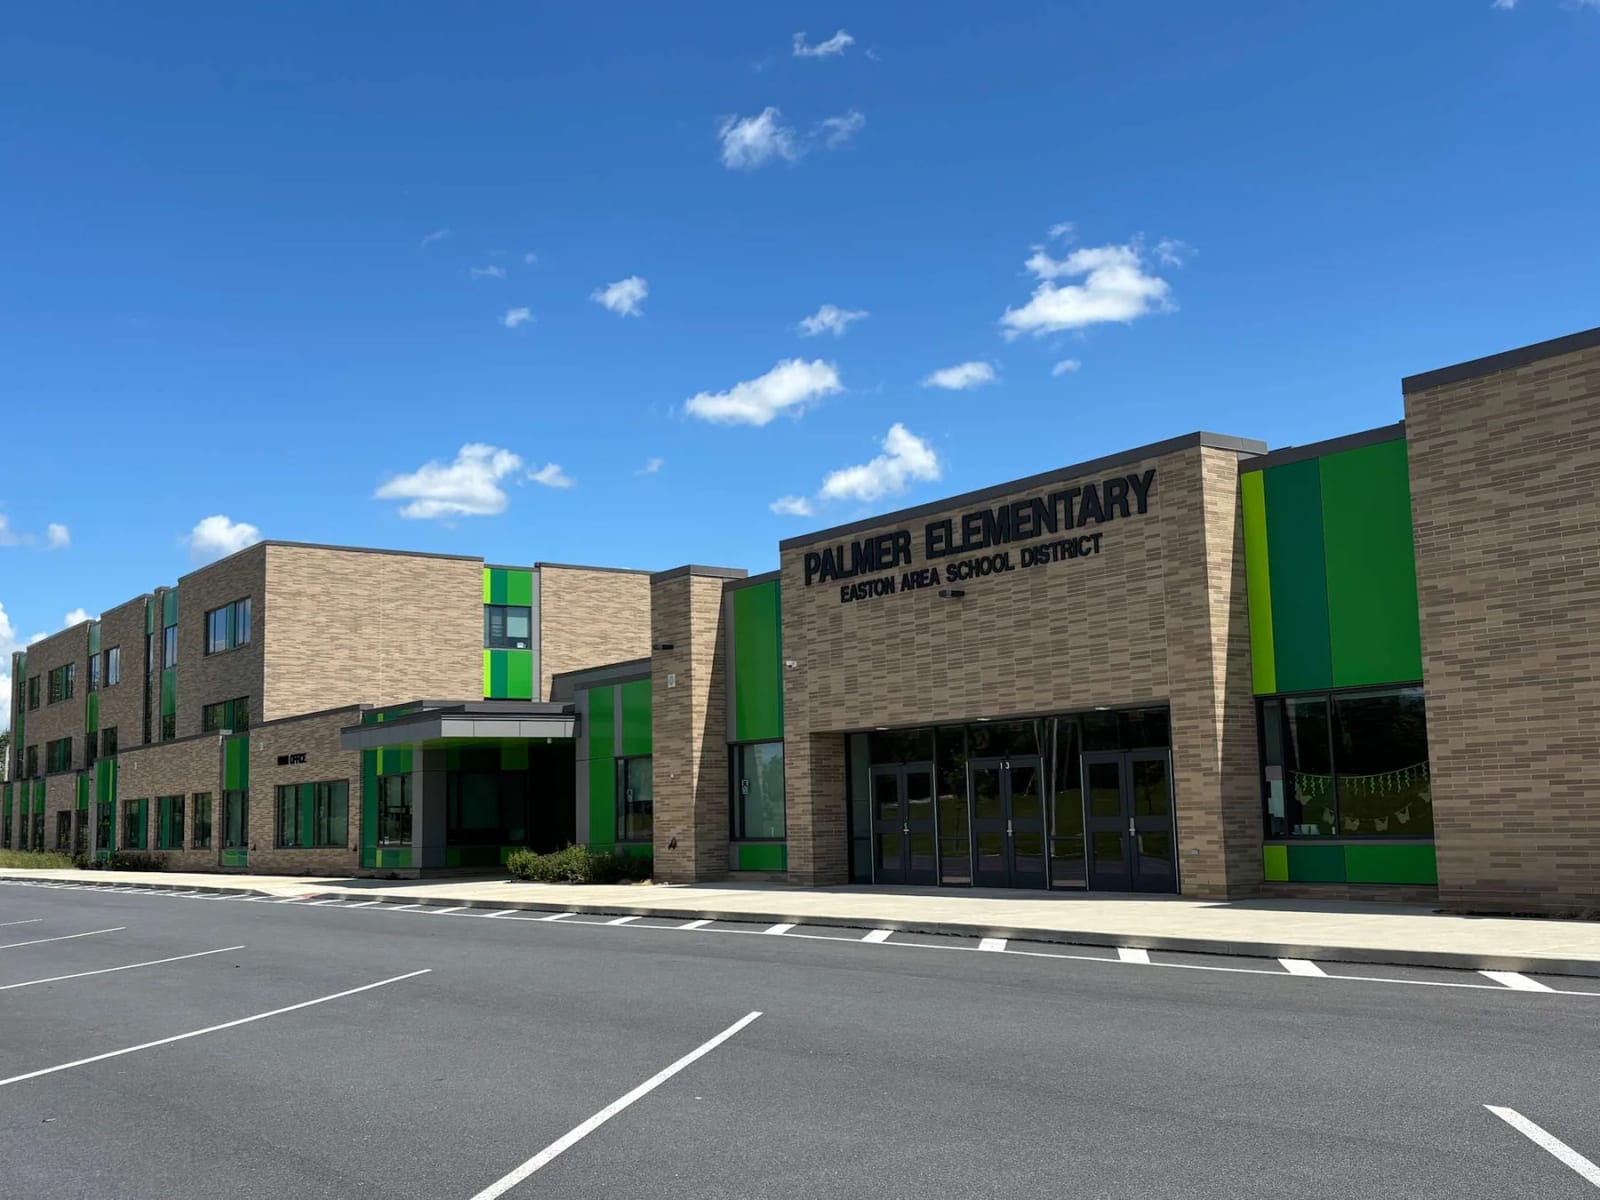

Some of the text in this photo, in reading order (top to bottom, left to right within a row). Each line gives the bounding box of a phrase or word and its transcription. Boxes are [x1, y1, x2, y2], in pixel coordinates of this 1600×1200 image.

[804, 469, 1156, 586] PALMER ELEMENTARY
[840, 532, 1103, 603] EASTON AREA SCHOOL DISTRICT
